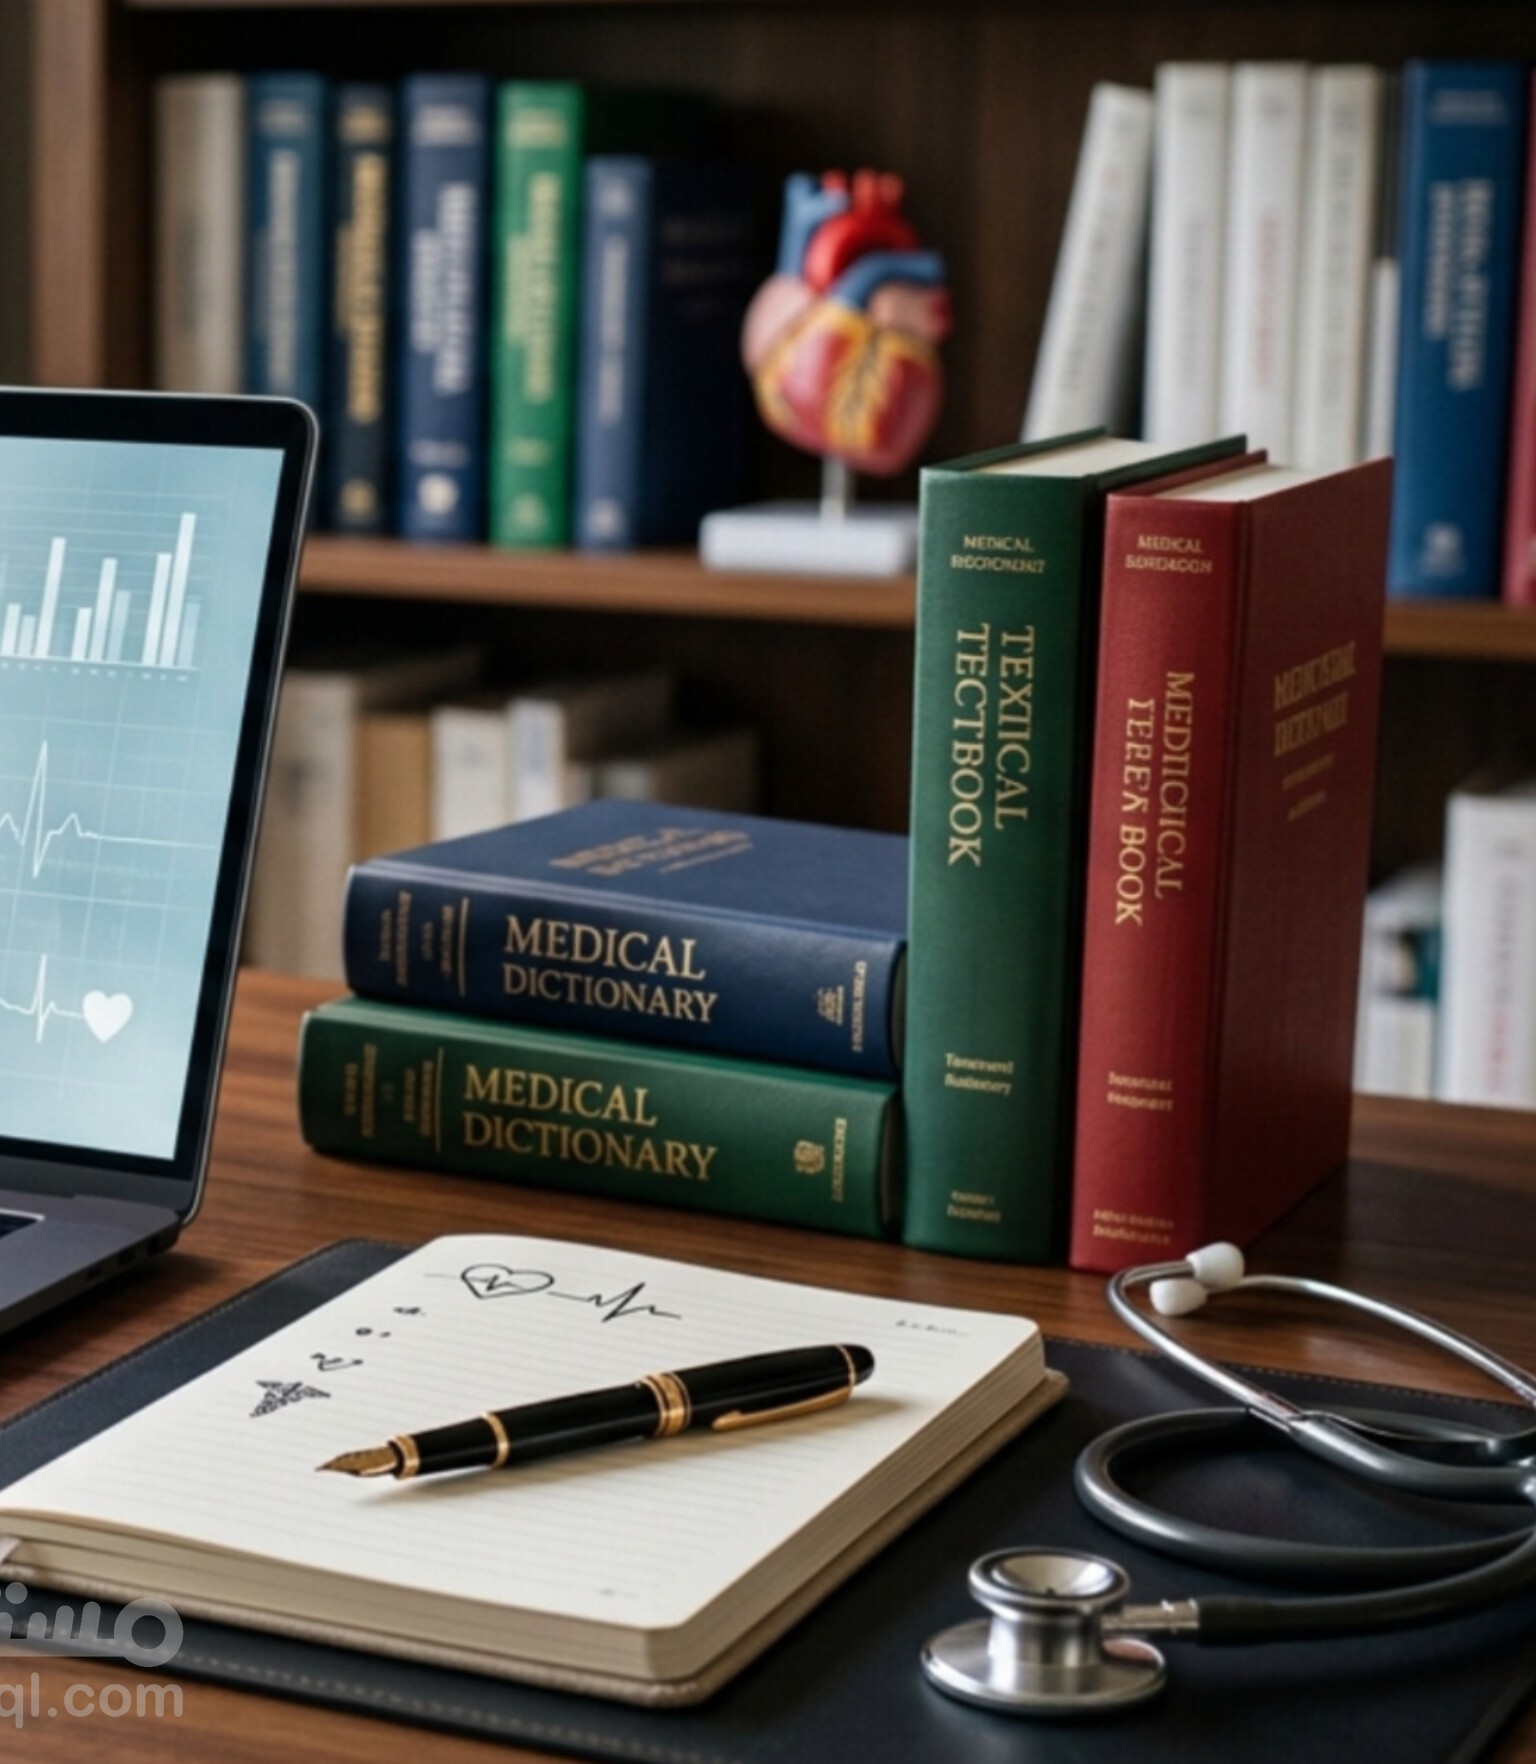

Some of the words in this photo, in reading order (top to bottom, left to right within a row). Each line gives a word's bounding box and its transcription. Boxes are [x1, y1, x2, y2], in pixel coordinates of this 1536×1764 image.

[948, 623, 990, 866] TECTBOOK
[1115, 823, 1148, 926] BOOK
[504, 914, 706, 980] MEDICAL
[502, 962, 718, 1023] DICTIONARY
[464, 1064, 658, 1127] MEDICAL
[462, 1112, 717, 1180] DICTIONARY
